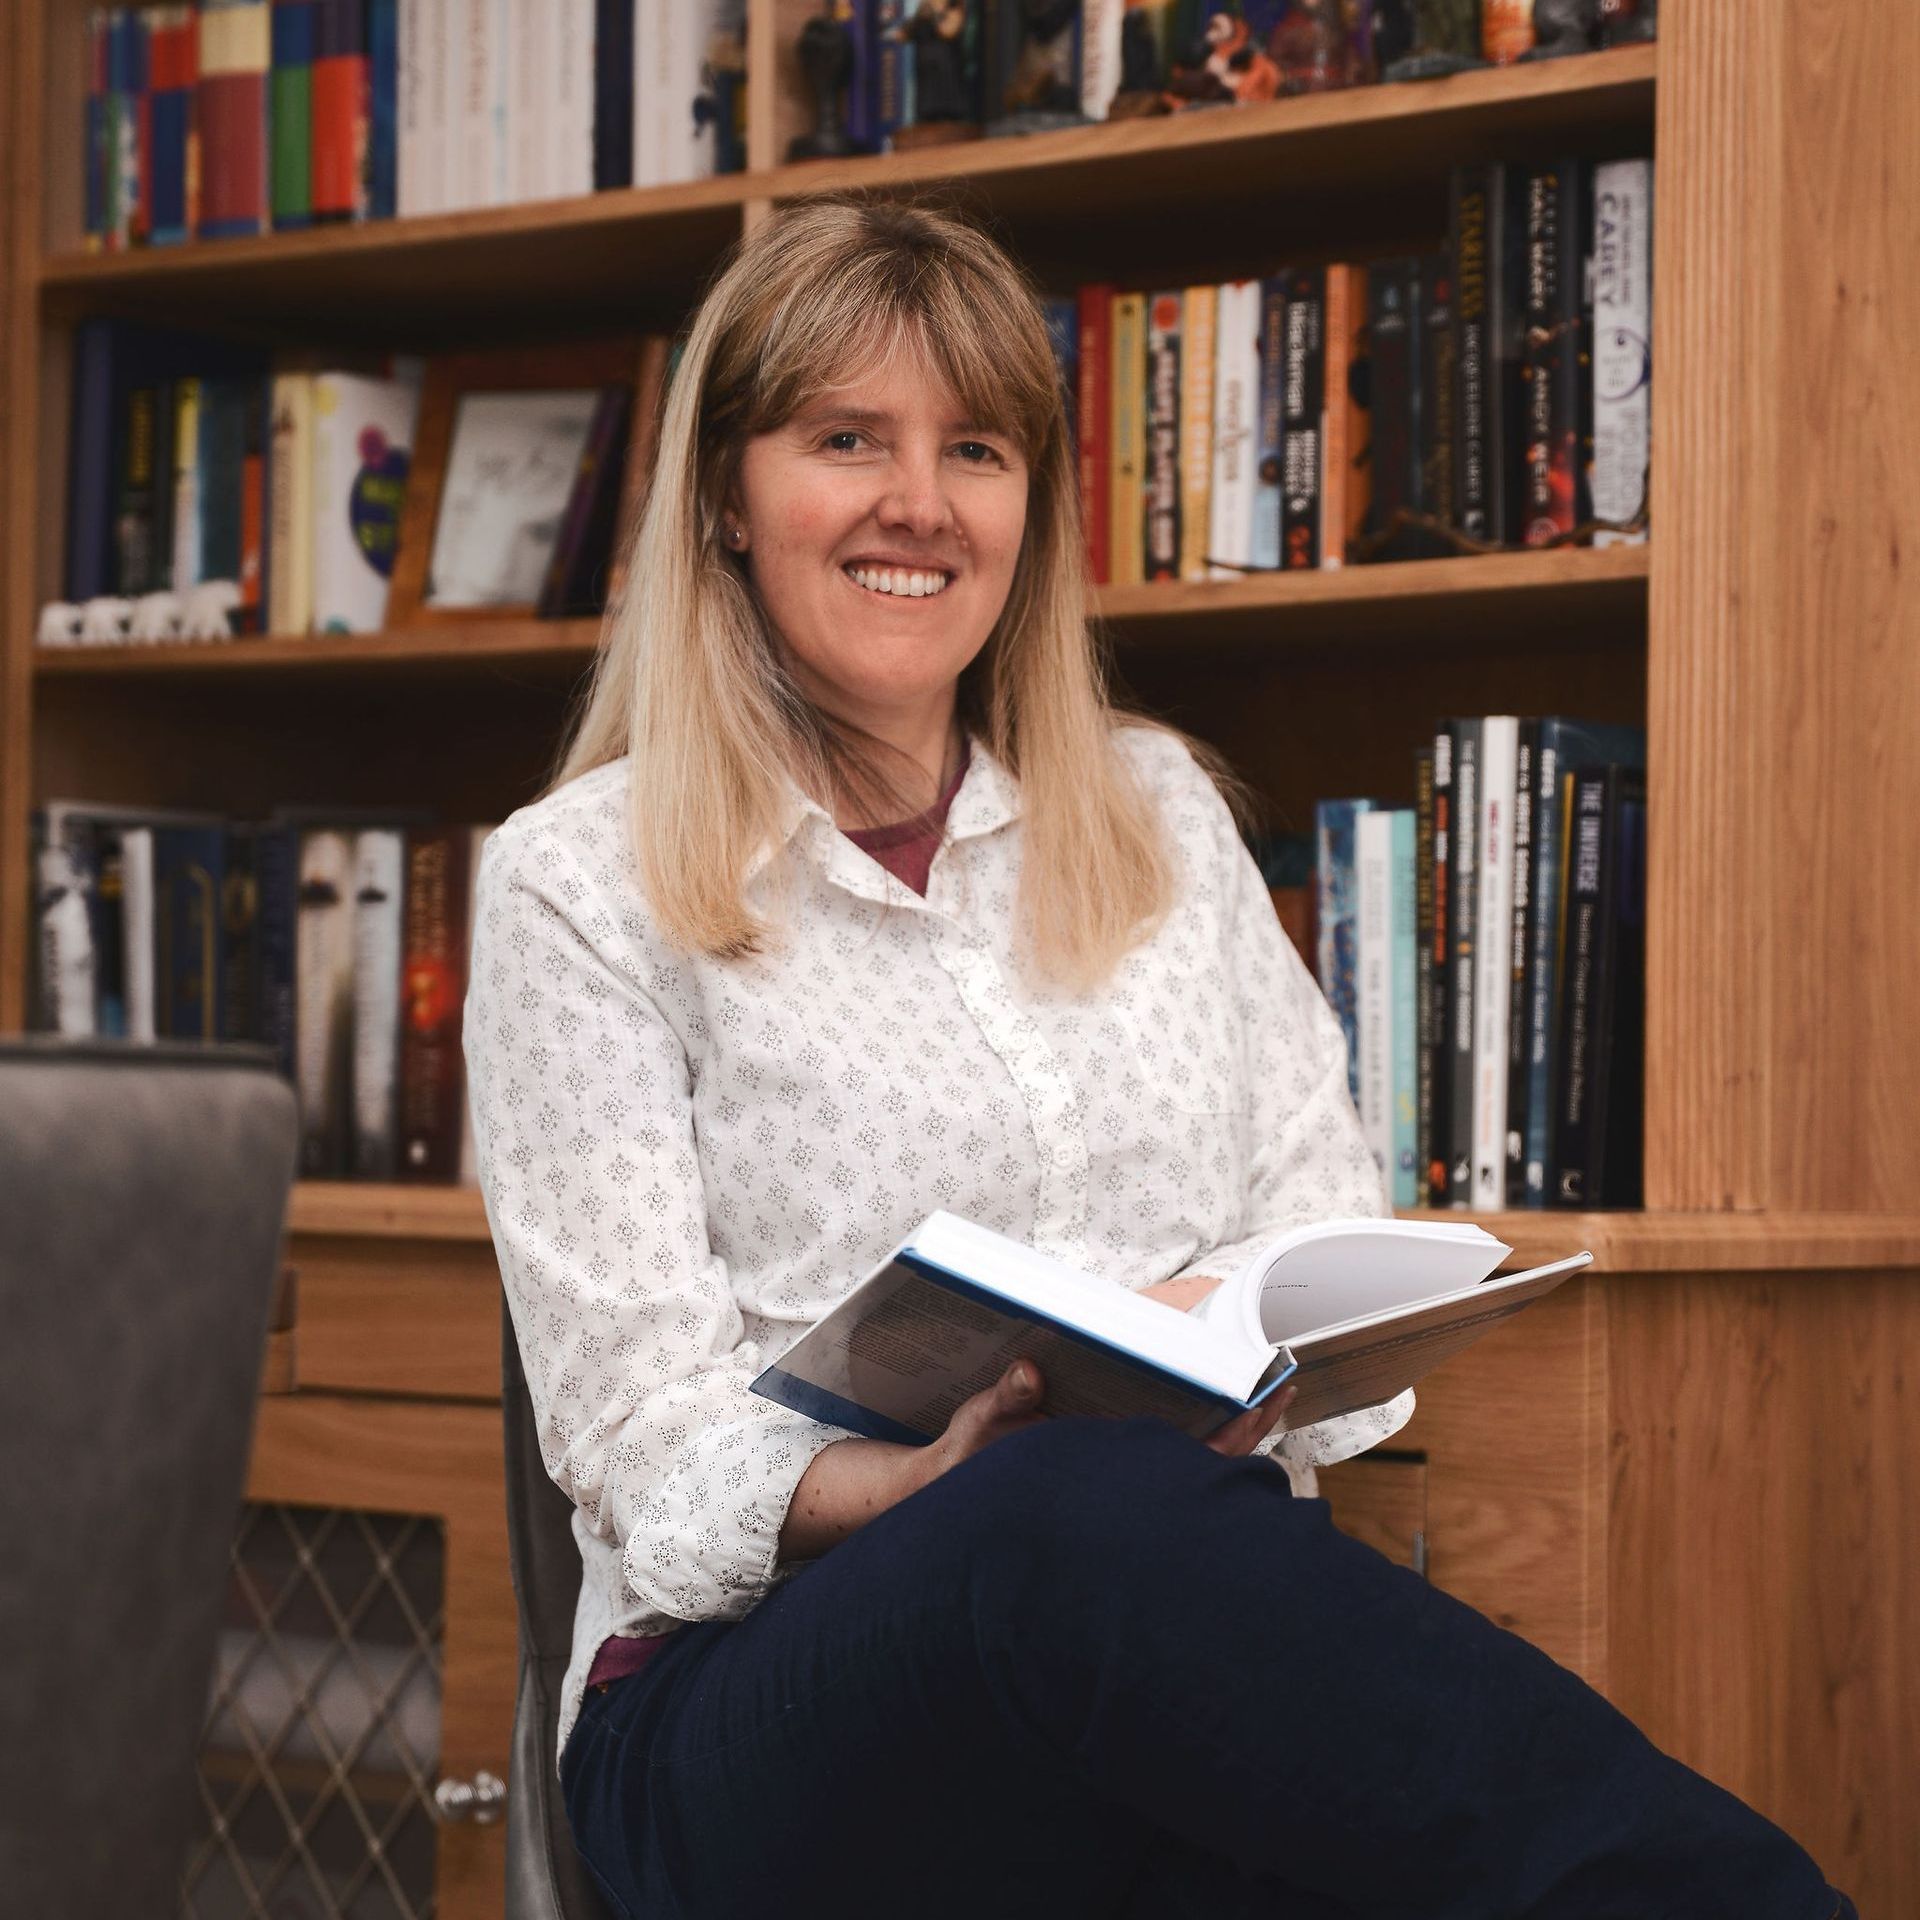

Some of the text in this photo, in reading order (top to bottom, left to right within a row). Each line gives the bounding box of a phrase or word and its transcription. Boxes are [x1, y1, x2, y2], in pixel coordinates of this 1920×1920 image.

[1599, 192, 1618, 307] CAREY
[1286, 302, 1306, 415] blackman
[1459, 192, 1484, 502] STARLESS JACQUELINE CAREY
[1529, 178, 1550, 505] HAIL MARY ANDY WEIR
[1540, 748, 1556, 799] RIFFS
[1581, 781, 1604, 812] THE
[1517, 790, 1531, 846] WRITE
[1514, 848, 1530, 908] SONGS
[1576, 815, 1602, 893] UNIVERSE
[1576, 903, 1594, 954] Heather
[1574, 1007, 1587, 1031] and
[1571, 1032, 1586, 1071] David
